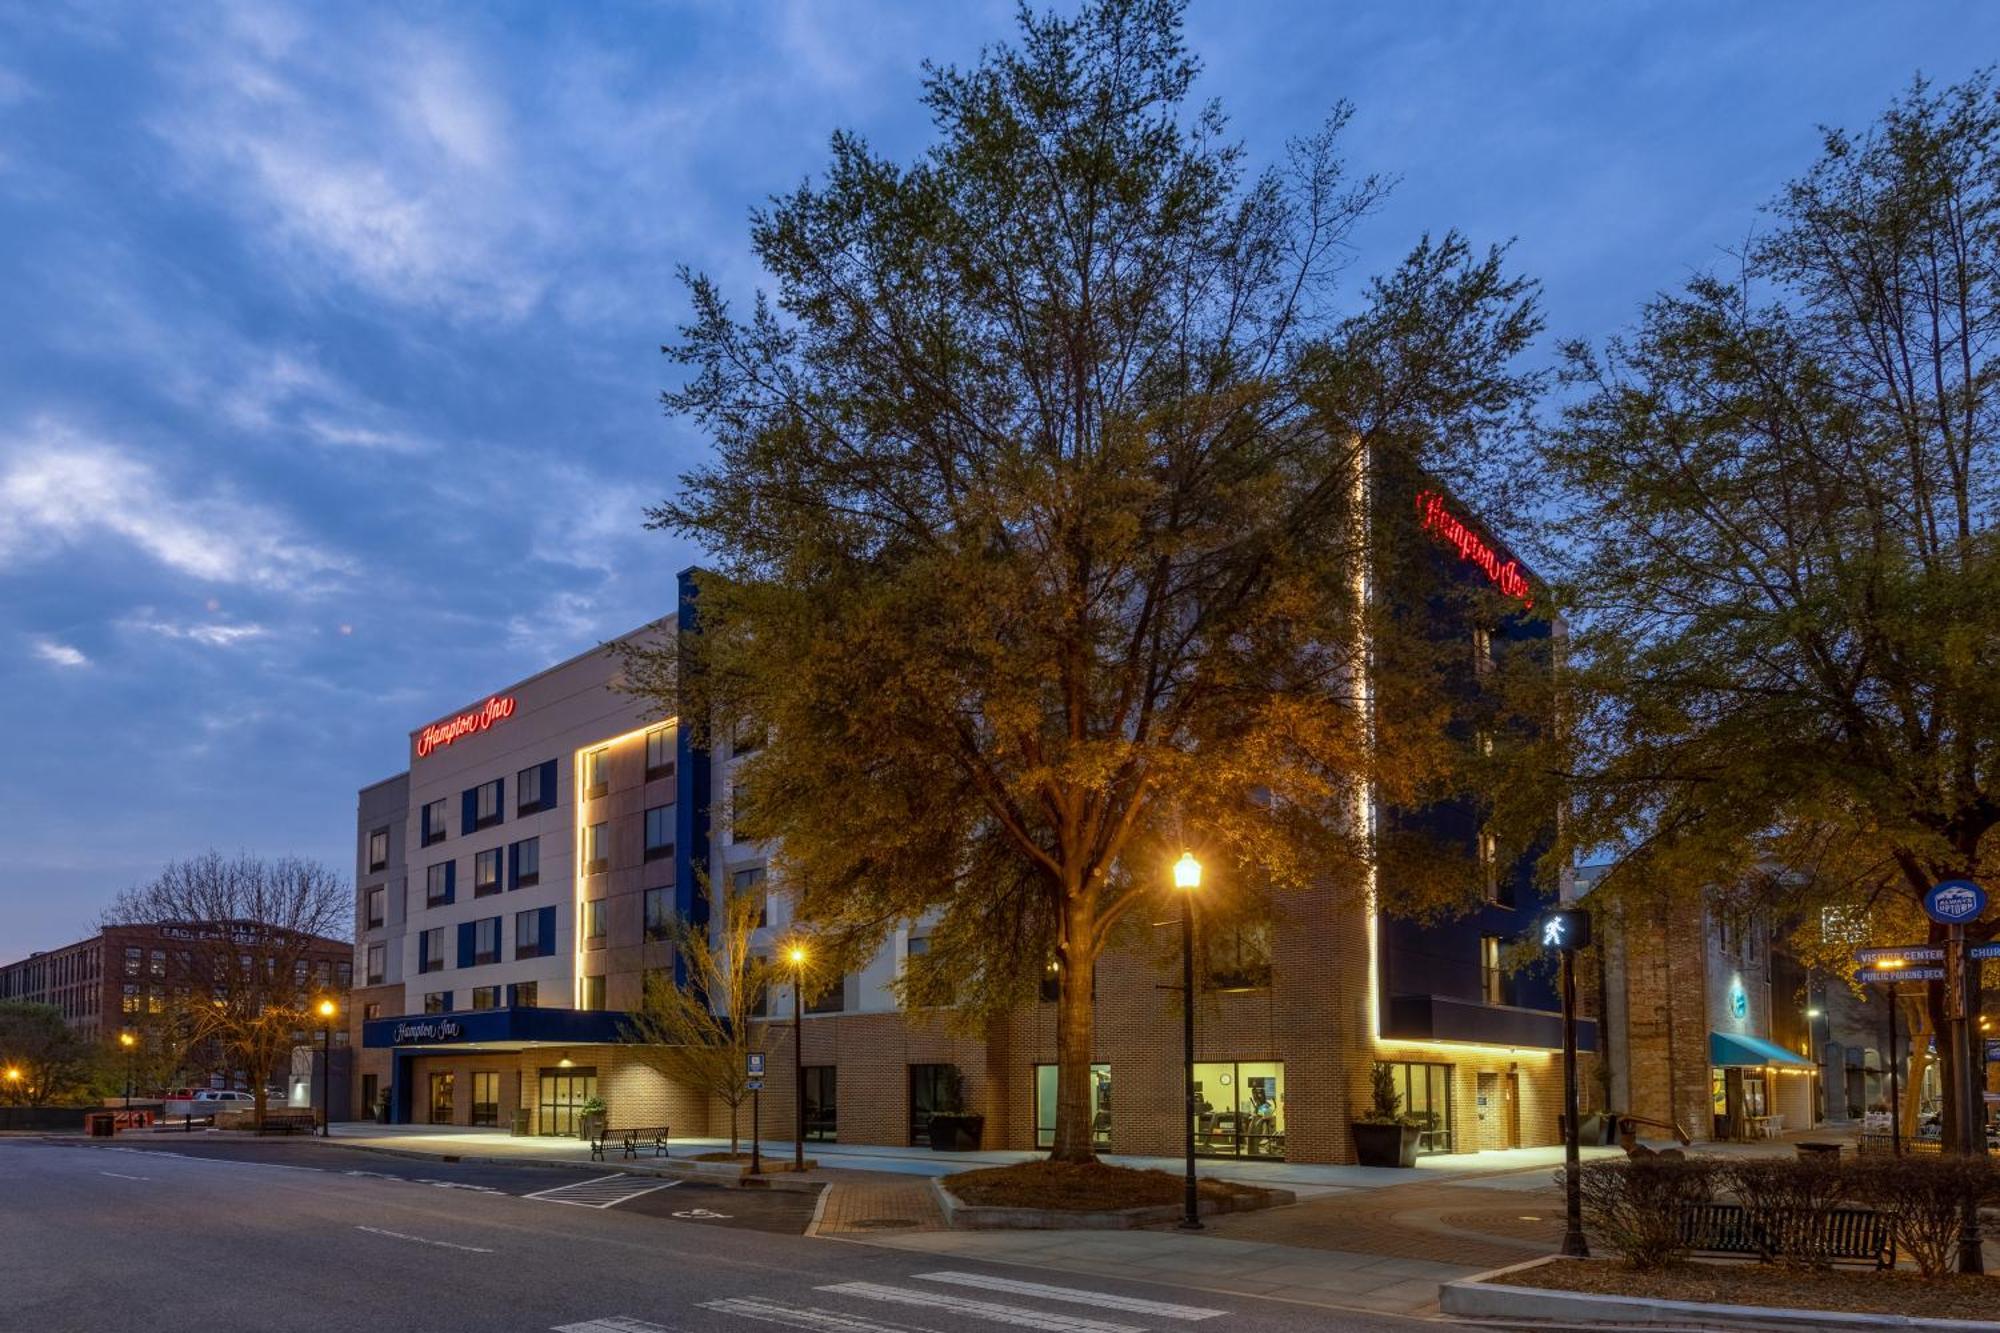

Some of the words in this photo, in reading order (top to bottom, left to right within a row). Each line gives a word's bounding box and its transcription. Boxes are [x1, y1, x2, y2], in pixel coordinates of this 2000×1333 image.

[1415, 490, 1500, 580] Hampton
[418, 715, 479, 756] Hampton
[480, 697, 514, 729] Inn
[1939, 903, 1973, 914] UPTOWN
[1861, 953, 1901, 962] VISITOR
[1903, 950, 1944, 960] CENTER
[1862, 971, 1889, 981] PUBLIC
[1891, 970, 1922, 980] PARKING
[1923, 969, 1944, 979] DECK
[394, 1022, 437, 1042] Hampton
[437, 1019, 460, 1040] Inn
